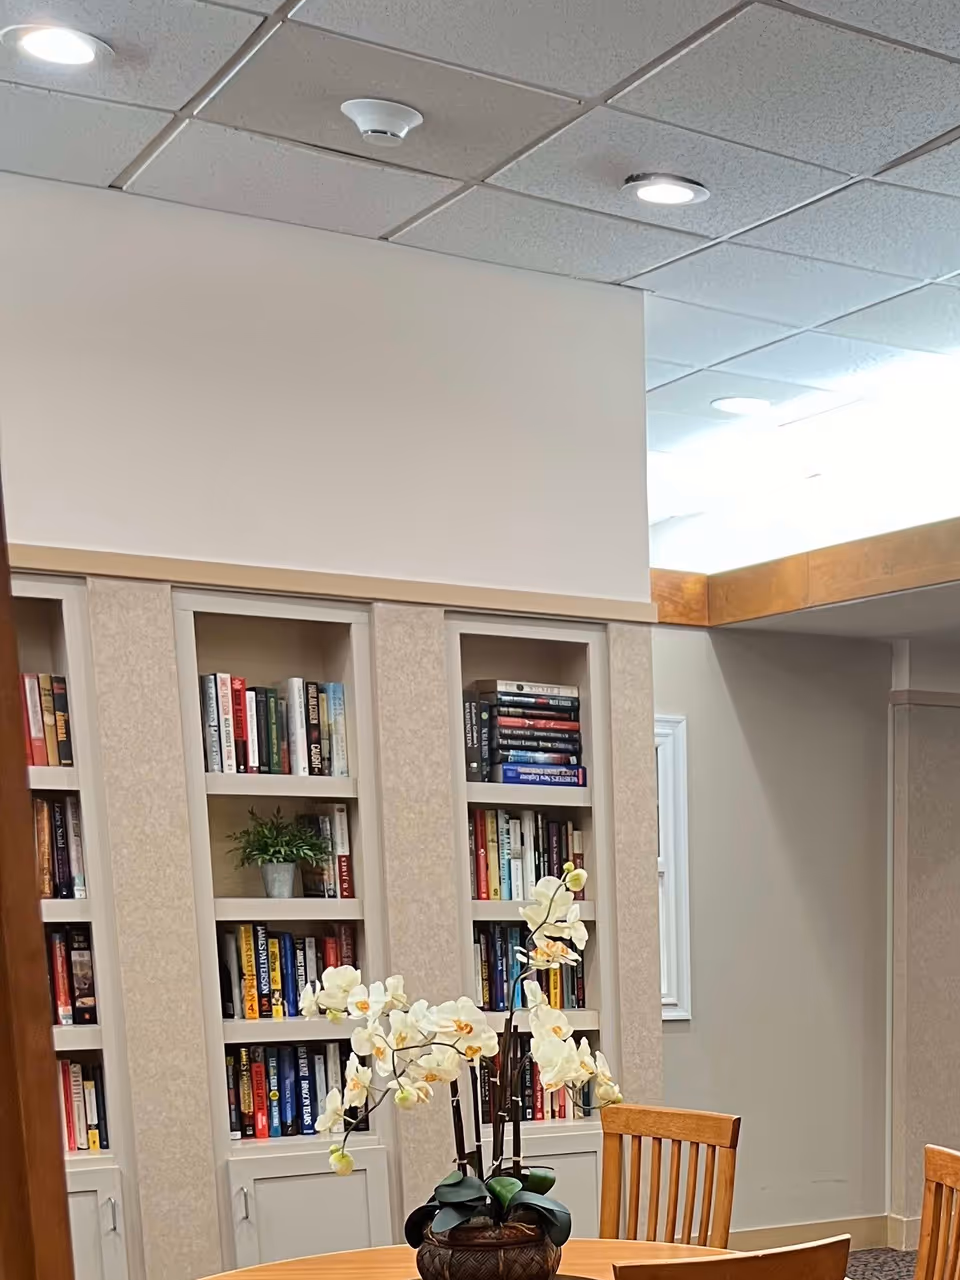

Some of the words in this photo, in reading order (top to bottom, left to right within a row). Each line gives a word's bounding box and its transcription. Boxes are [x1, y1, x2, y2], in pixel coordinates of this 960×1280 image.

[308, 684, 317, 705] HARLAN
[309, 705, 318, 724] COBEN
[464, 702, 472, 748] WASHINGTON
[310, 744, 321, 768] CAUGHT
[57, 828, 65, 847] Stahl
[341, 857, 349, 880] JAMES
[256, 926, 267, 950] JAMES
[296, 949, 304, 966] JAMES
[258, 950, 269, 994] PATTERSON
[299, 1058, 309, 1077] KOONTZ
[270, 1075, 278, 1090] CHILD
[301, 1080, 311, 1105] DRAGON
[303, 1106, 312, 1125] TEARS
